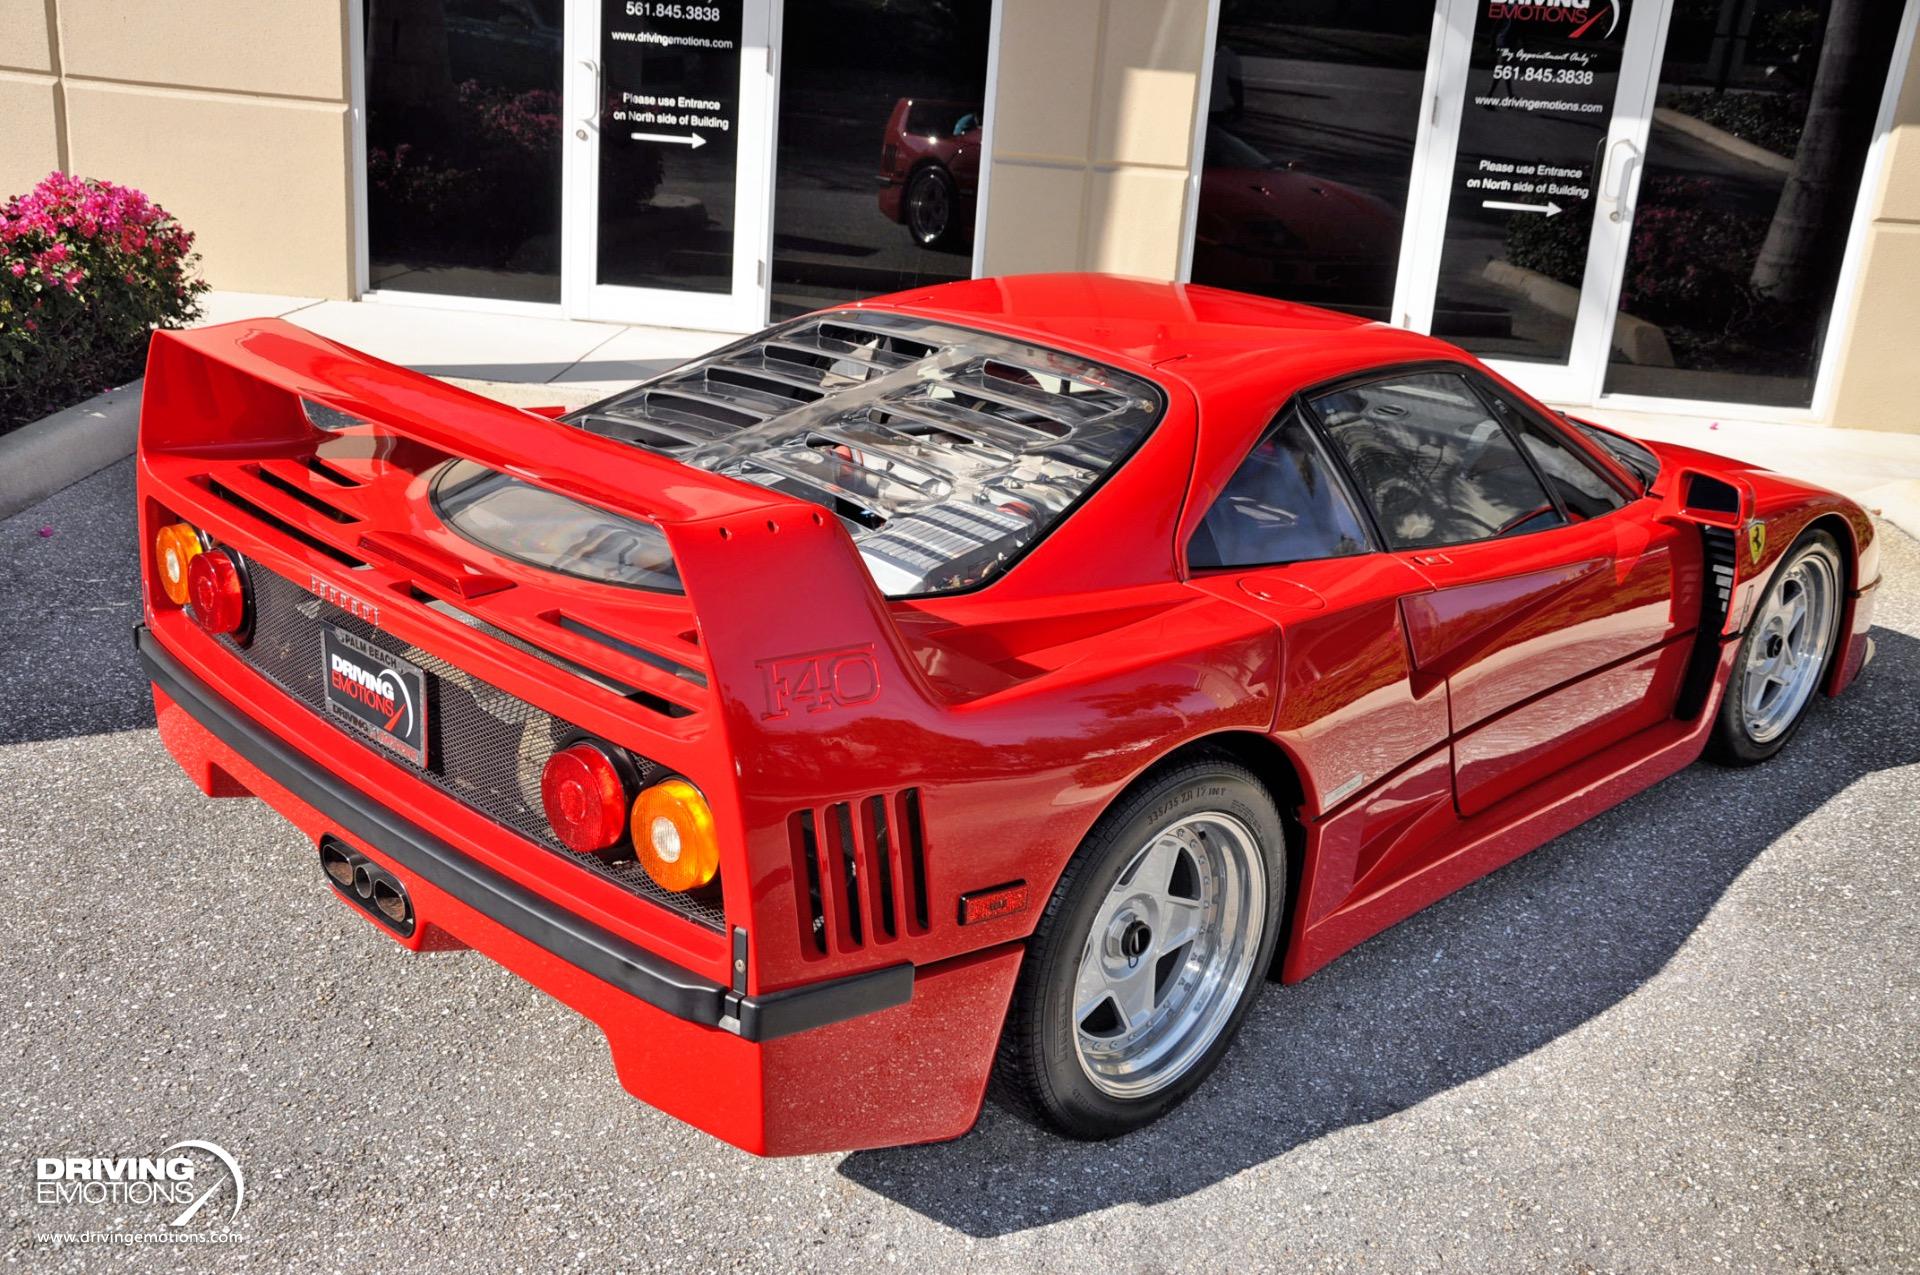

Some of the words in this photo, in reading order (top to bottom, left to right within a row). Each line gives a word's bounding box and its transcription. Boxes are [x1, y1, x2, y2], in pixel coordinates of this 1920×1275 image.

[626, 1, 720, 22] 561.845.3838
[1488, 4, 1588, 24] EMOTIONS
[611, 31, 733, 49] www.drivingemotions.com
[1516, 49, 1570, 62] Appointment
[1493, 65, 1594, 85] 561.845.3838
[623, 92, 656, 106] Please
[658, 96, 675, 107] use
[678, 97, 721, 110] Entrance
[1475, 95, 1603, 113] www.drivingemotions.com
[613, 110, 626, 121] on
[628, 109, 655, 123] North
[657, 110, 677, 124] side
[679, 112, 689, 125] of
[691, 115, 729, 131] Building
[1479, 160, 1514, 174] Please
[1516, 164, 1535, 175] use
[1537, 165, 1583, 179] Entrance
[1467, 179, 1480, 189] on
[1482, 178, 1511, 192] North
[1512, 181, 1534, 193] side
[1536, 181, 1547, 194] of
[1548, 184, 1589, 199] Building
[344, 635, 366, 654] PALM
[369, 646, 397, 667] BEACH
[331, 653, 395, 700] DRIVING
[754, 642, 880, 720] F40
[331, 670, 395, 719] EMOTIONS
[333, 703, 369, 732] DRIVING
[1147, 797, 1179, 825] 335/35
